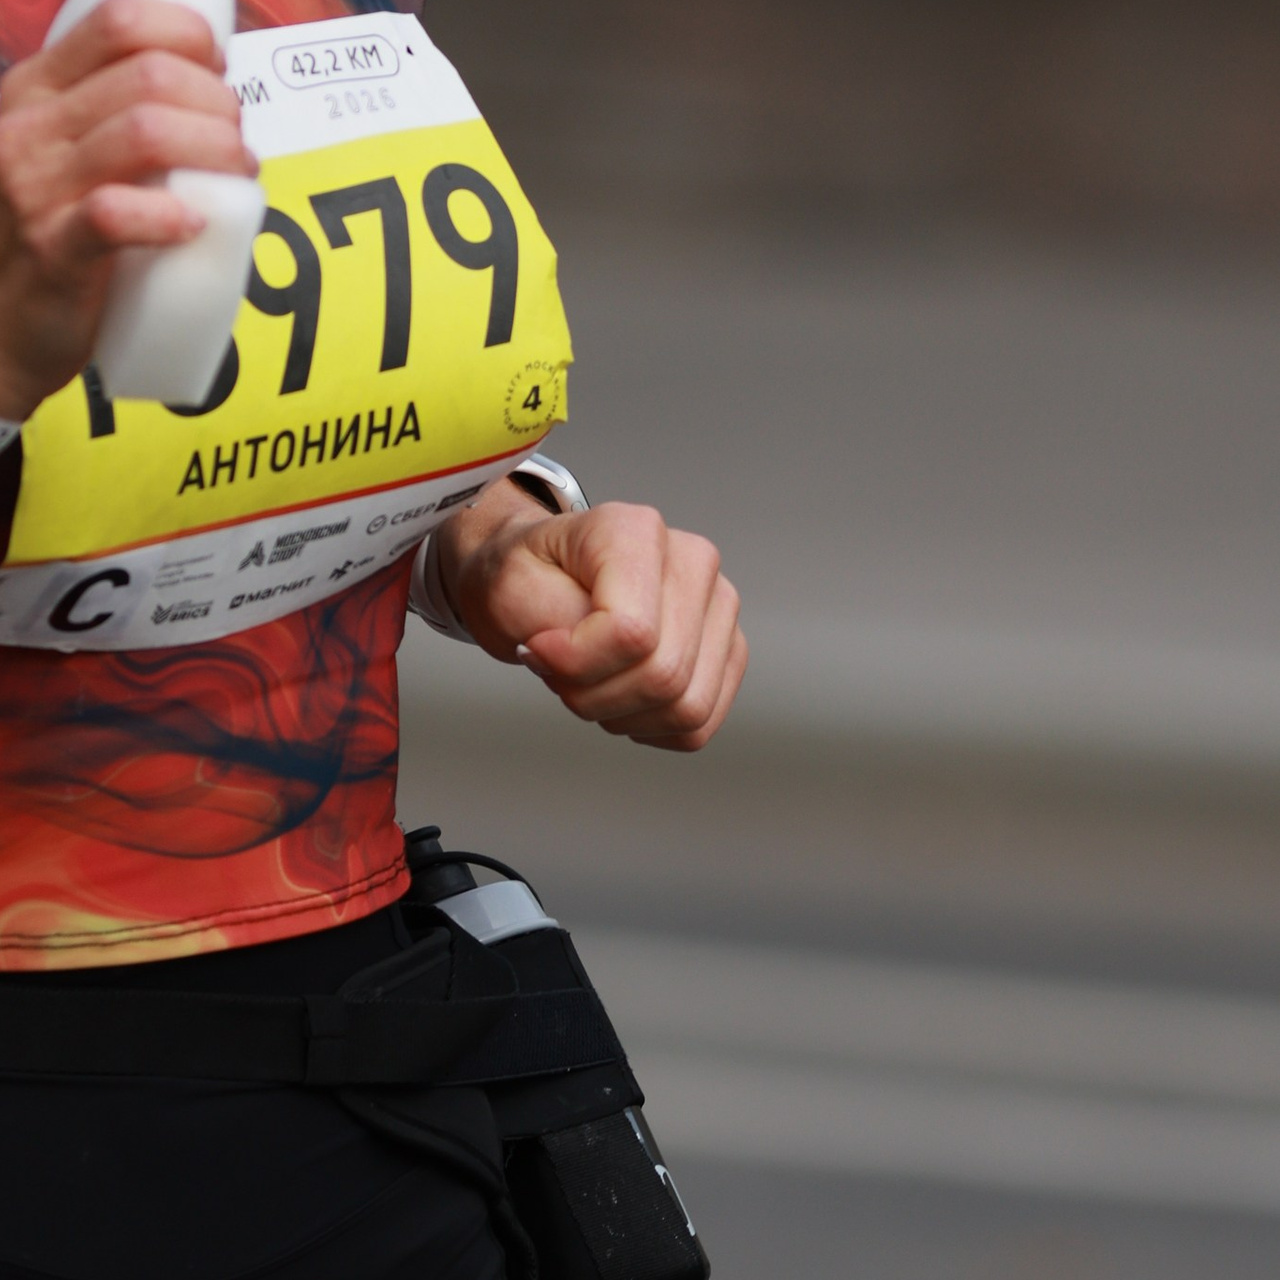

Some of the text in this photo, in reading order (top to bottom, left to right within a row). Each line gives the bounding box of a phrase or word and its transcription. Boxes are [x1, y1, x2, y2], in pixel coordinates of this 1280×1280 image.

[291, 48, 342, 78] 42,2
[324, 86, 396, 120] 2026
[81, 162, 519, 441] 979
[521, 384, 542, 412] 4
[176, 400, 422, 497] АНТОНИНА
[275, 517, 352, 549] МОСКОВСКИЙ
[267, 543, 307, 566] СПОРТ
